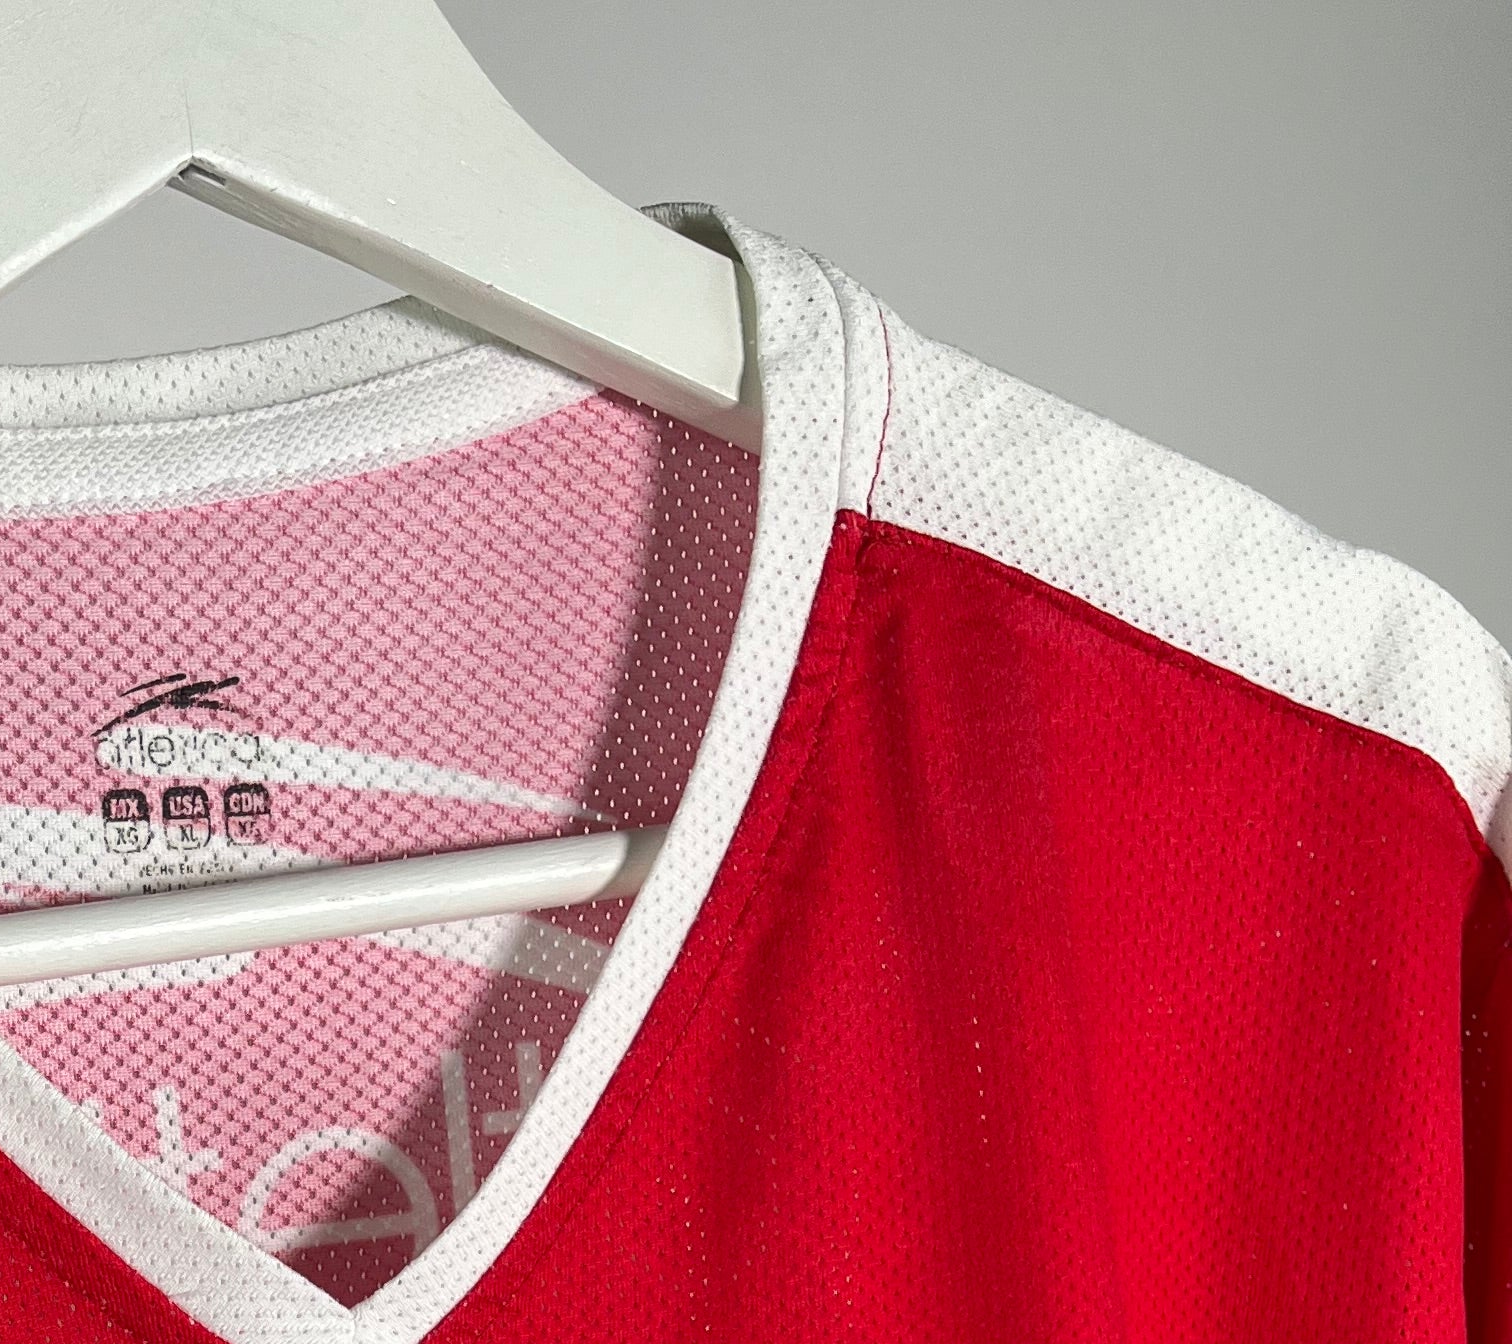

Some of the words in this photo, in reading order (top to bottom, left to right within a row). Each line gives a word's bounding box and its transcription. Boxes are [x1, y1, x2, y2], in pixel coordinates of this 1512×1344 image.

[110, 799, 140, 818] MX
[169, 794, 206, 816] USA
[228, 791, 265, 813] CDN
[179, 823, 199, 843] XL
